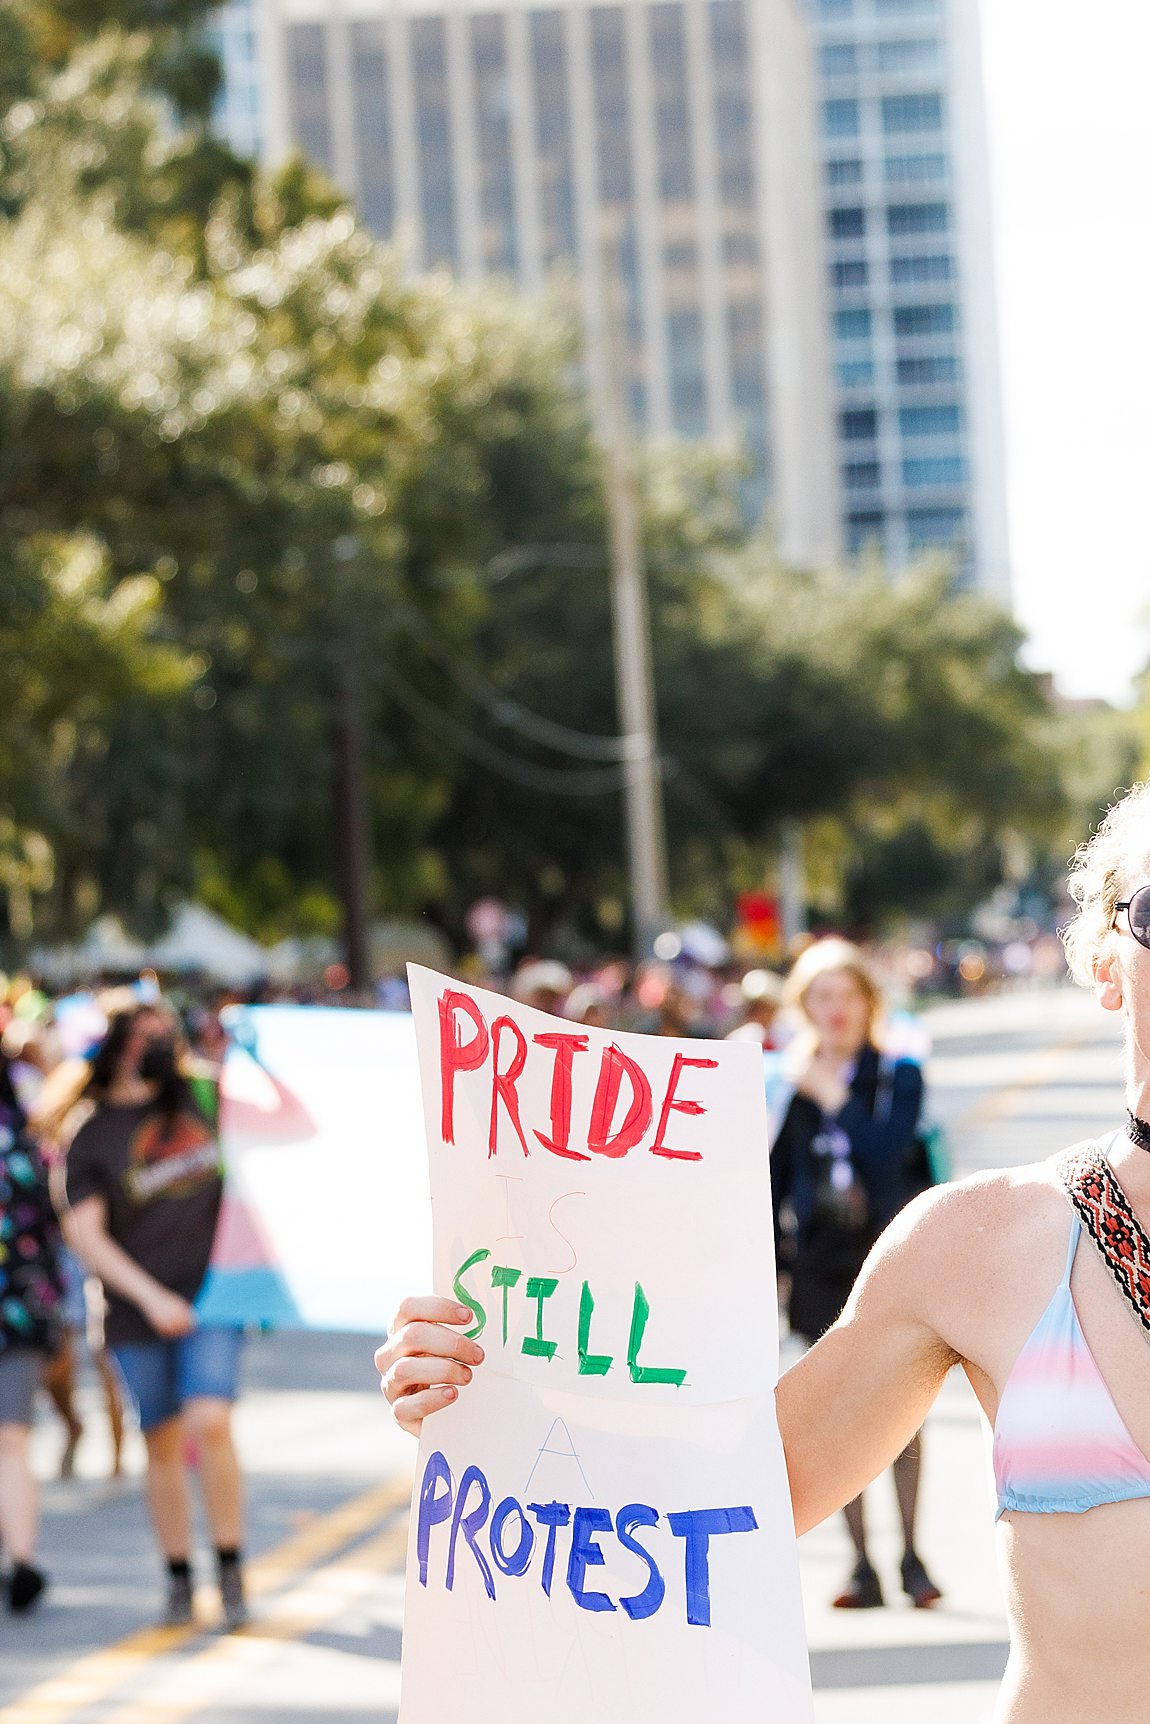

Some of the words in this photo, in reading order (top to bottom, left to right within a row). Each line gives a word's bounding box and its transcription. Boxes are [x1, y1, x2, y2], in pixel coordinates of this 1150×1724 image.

[438, 988, 719, 1161] PRIDE
[495, 1174, 586, 1274] IS
[453, 1250, 692, 1387] STILL
[524, 1417, 595, 1499] A
[417, 1451, 759, 1627] PROTEST
